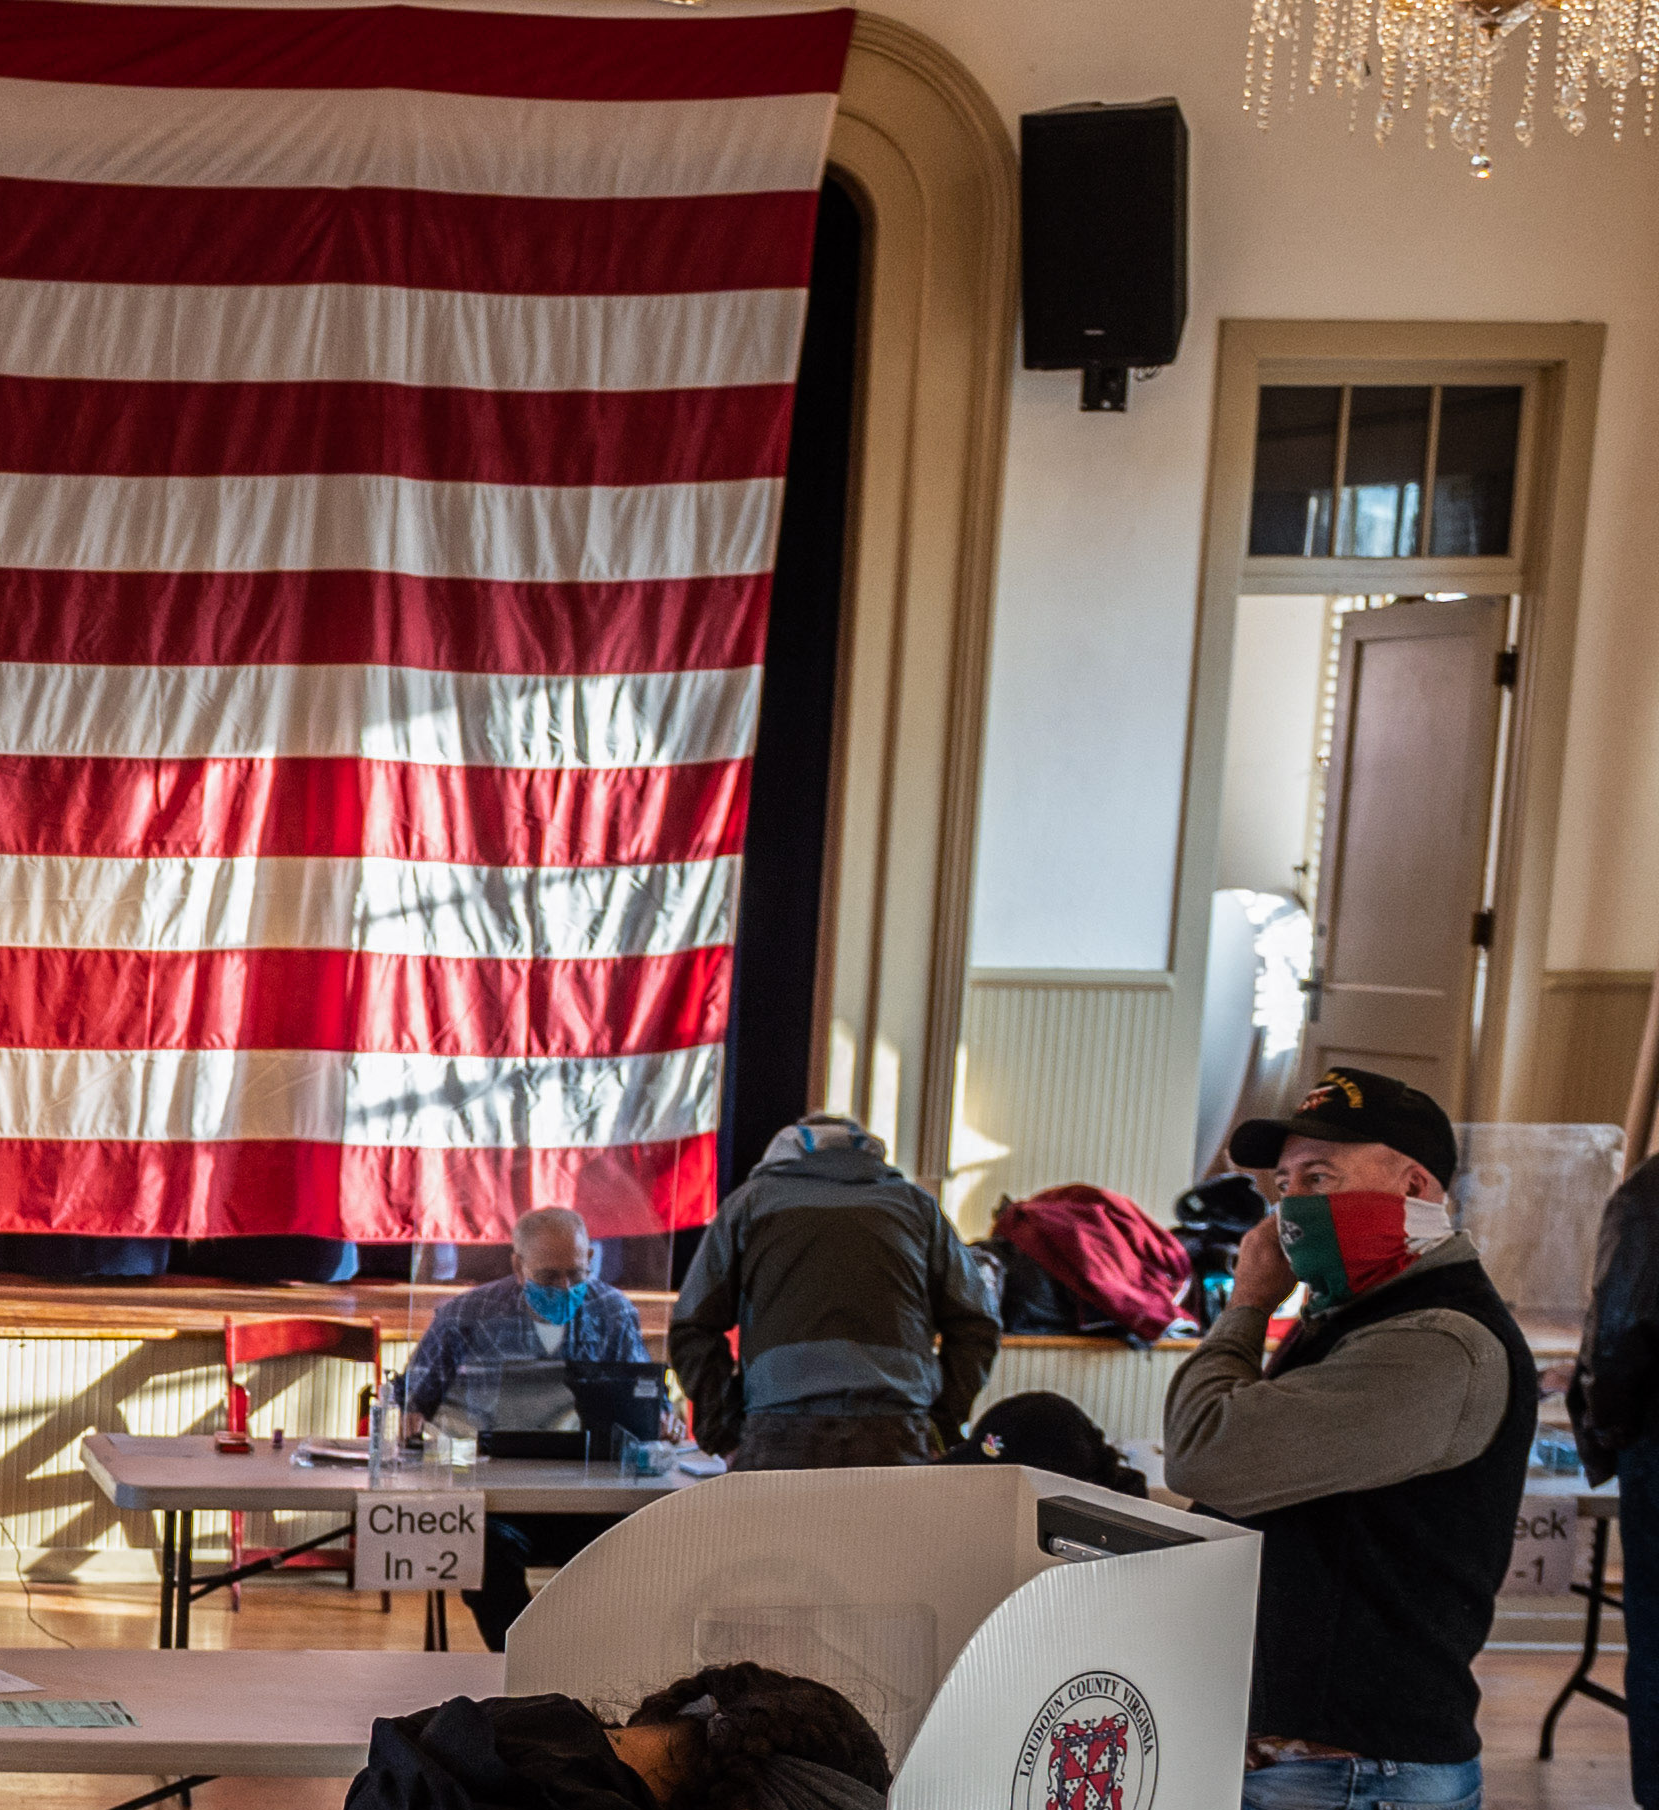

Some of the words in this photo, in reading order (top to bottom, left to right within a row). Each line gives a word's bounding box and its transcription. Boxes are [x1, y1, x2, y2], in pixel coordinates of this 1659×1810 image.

[369, 1504, 476, 1534] Check
[385, 1552, 412, 1580] In
[425, 1551, 458, 1580] -2
[1020, 1697, 1064, 1777] LOUDOUN
[1068, 1677, 1120, 1701] COUNTY
[1123, 1686, 1155, 1756] VIRGINIA
